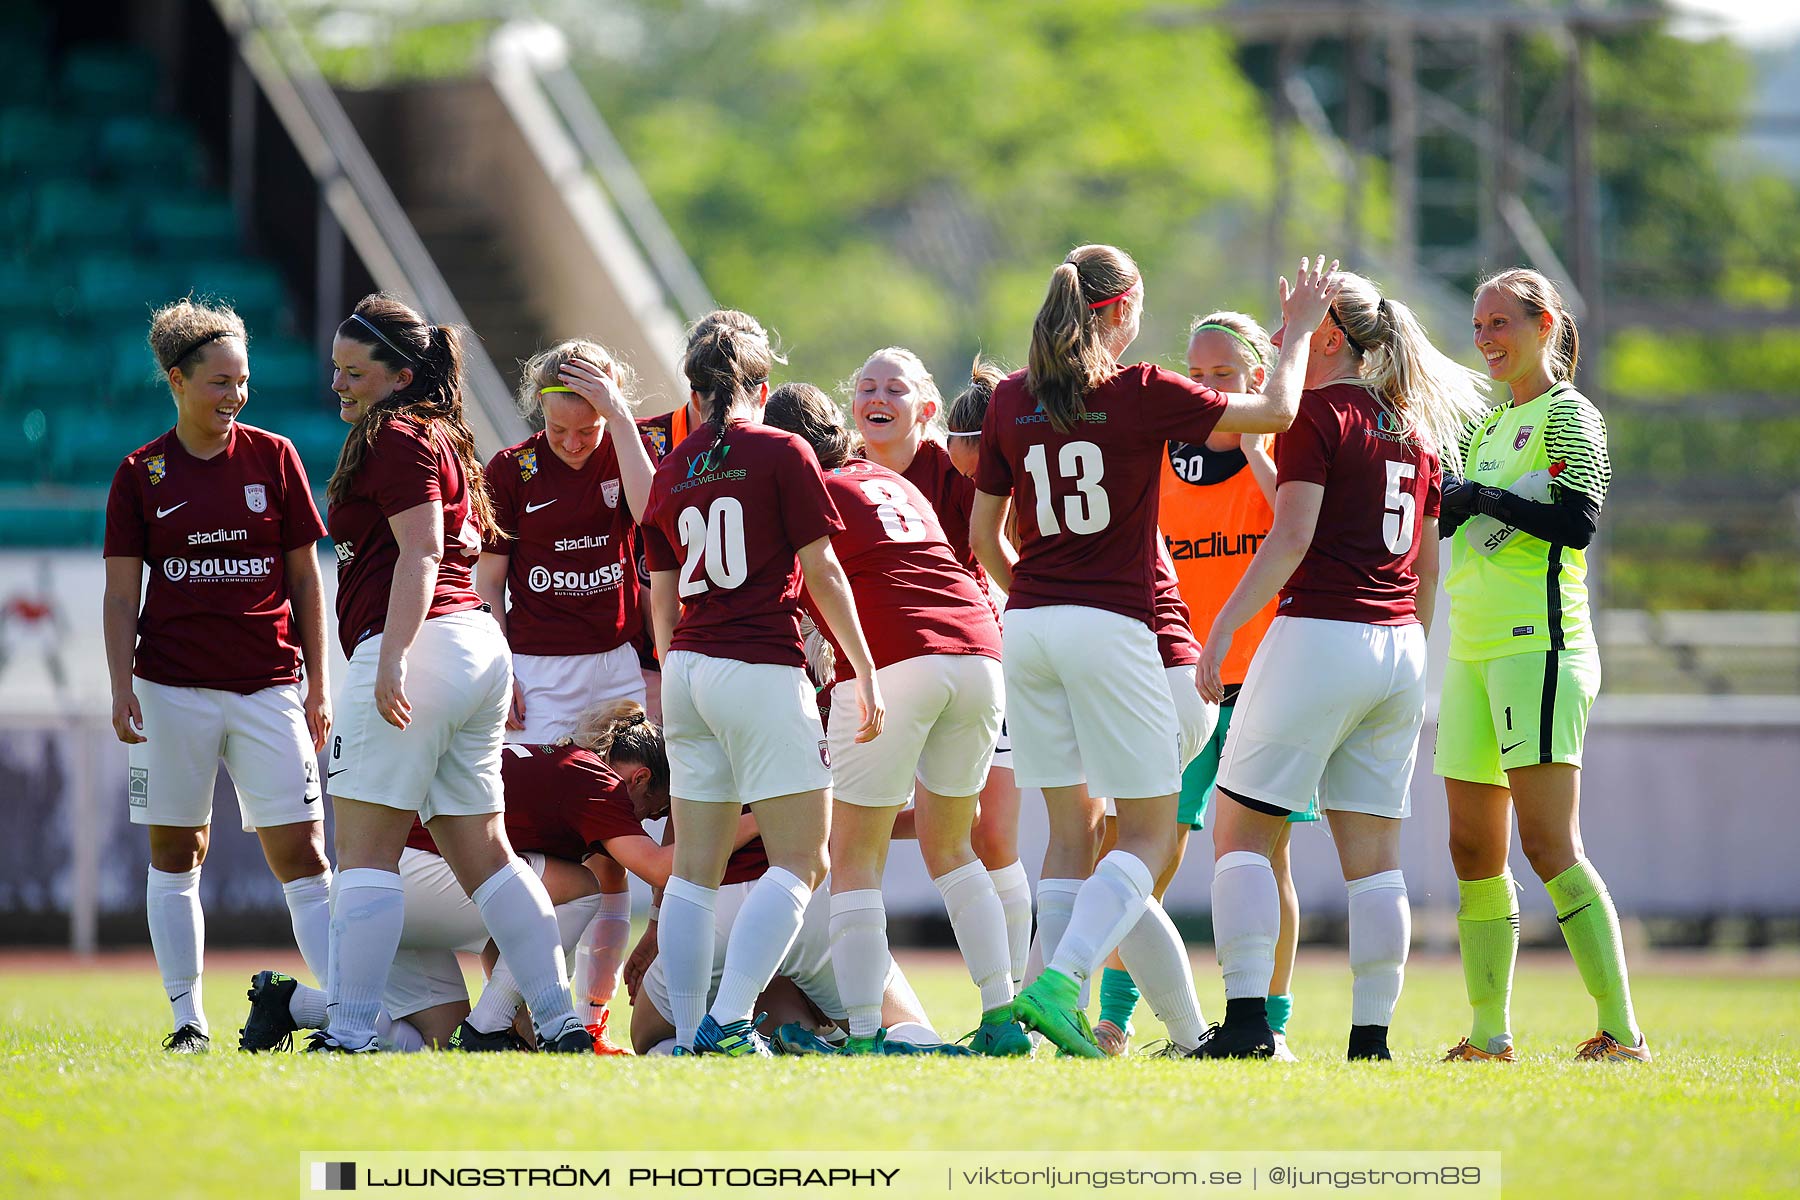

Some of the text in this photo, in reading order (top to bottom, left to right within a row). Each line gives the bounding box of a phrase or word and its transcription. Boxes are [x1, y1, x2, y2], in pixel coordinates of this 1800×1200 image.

[860, 479, 927, 542] 8
[1024, 441, 1110, 537] 13
[1383, 460, 1416, 555] 5
[188, 529, 247, 545] stadium
[678, 497, 748, 598] 20
[1165, 532, 1267, 560] tadium
[1505, 706, 1513, 730] 1
[333, 736, 342, 760] 6
